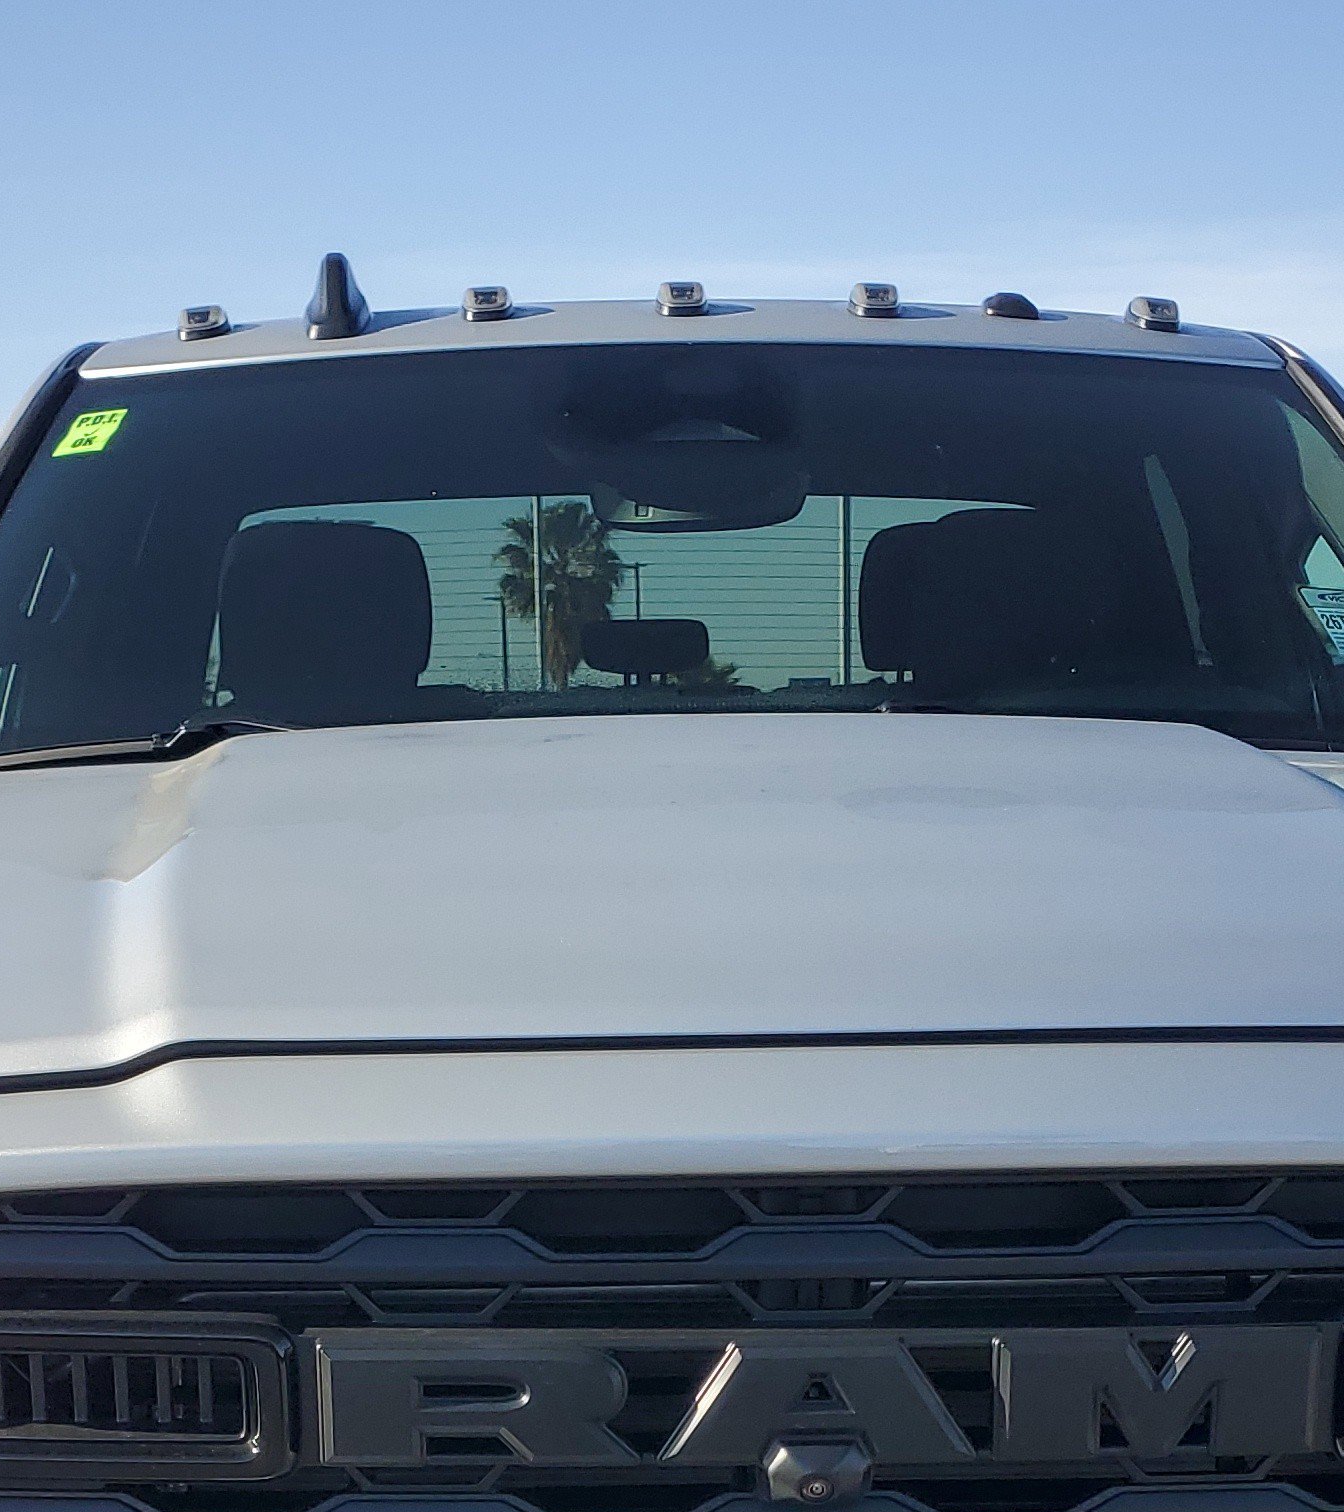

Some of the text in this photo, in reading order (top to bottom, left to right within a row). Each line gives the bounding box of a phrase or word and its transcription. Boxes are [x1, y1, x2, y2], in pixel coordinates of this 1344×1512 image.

[76, 412, 118, 428] P.D.I.
[71, 435, 98, 448] OK
[313, 1332, 1324, 1467] RAM
